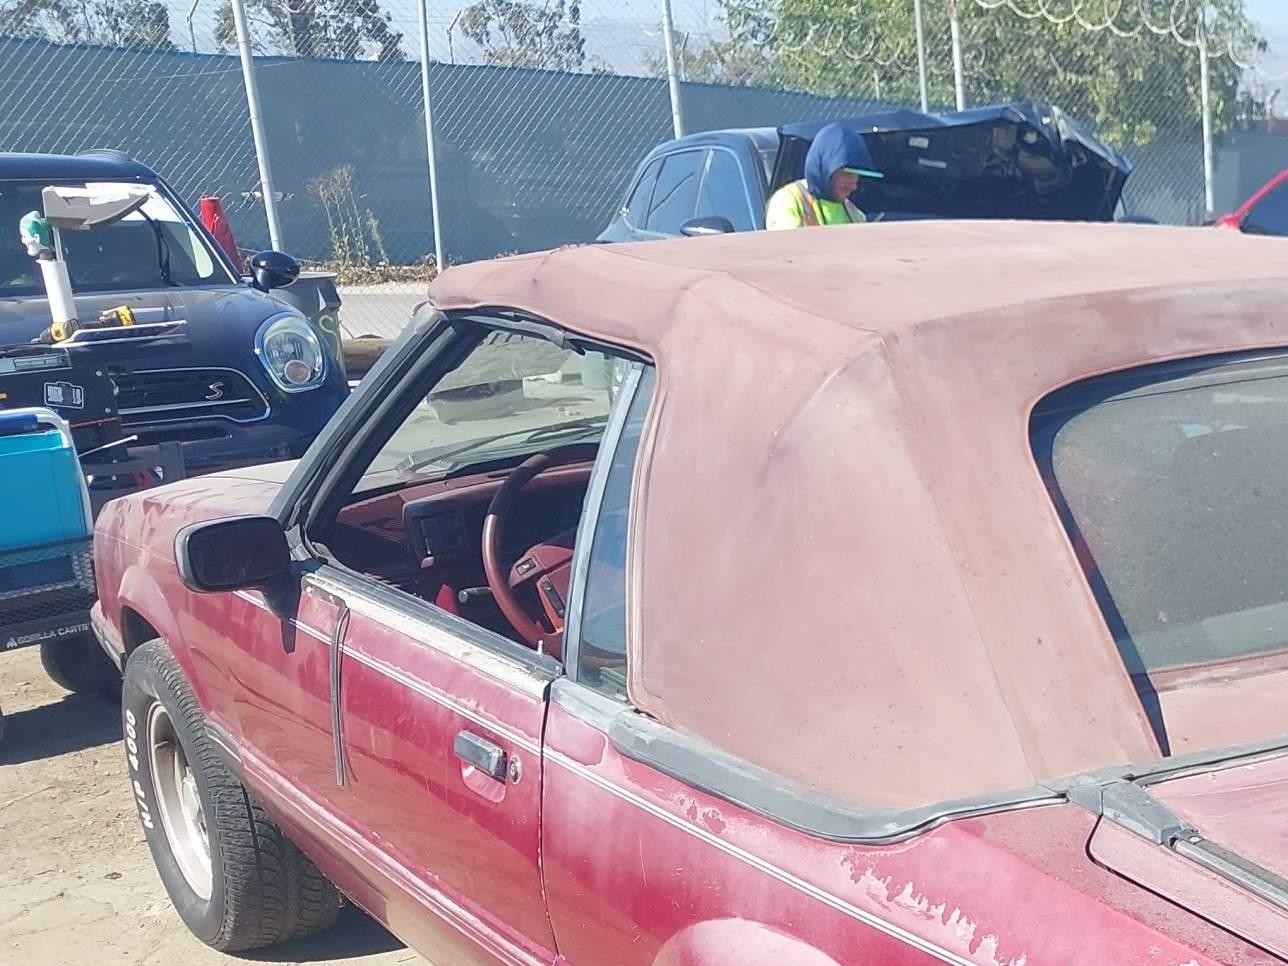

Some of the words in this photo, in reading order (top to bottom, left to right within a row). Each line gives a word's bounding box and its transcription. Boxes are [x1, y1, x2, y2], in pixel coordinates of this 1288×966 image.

[17, 630, 57, 645] GORILLA
[57, 623, 89, 636] CARTS
[126, 709, 139, 771] 4000
[134, 780, 154, 829] H/P
